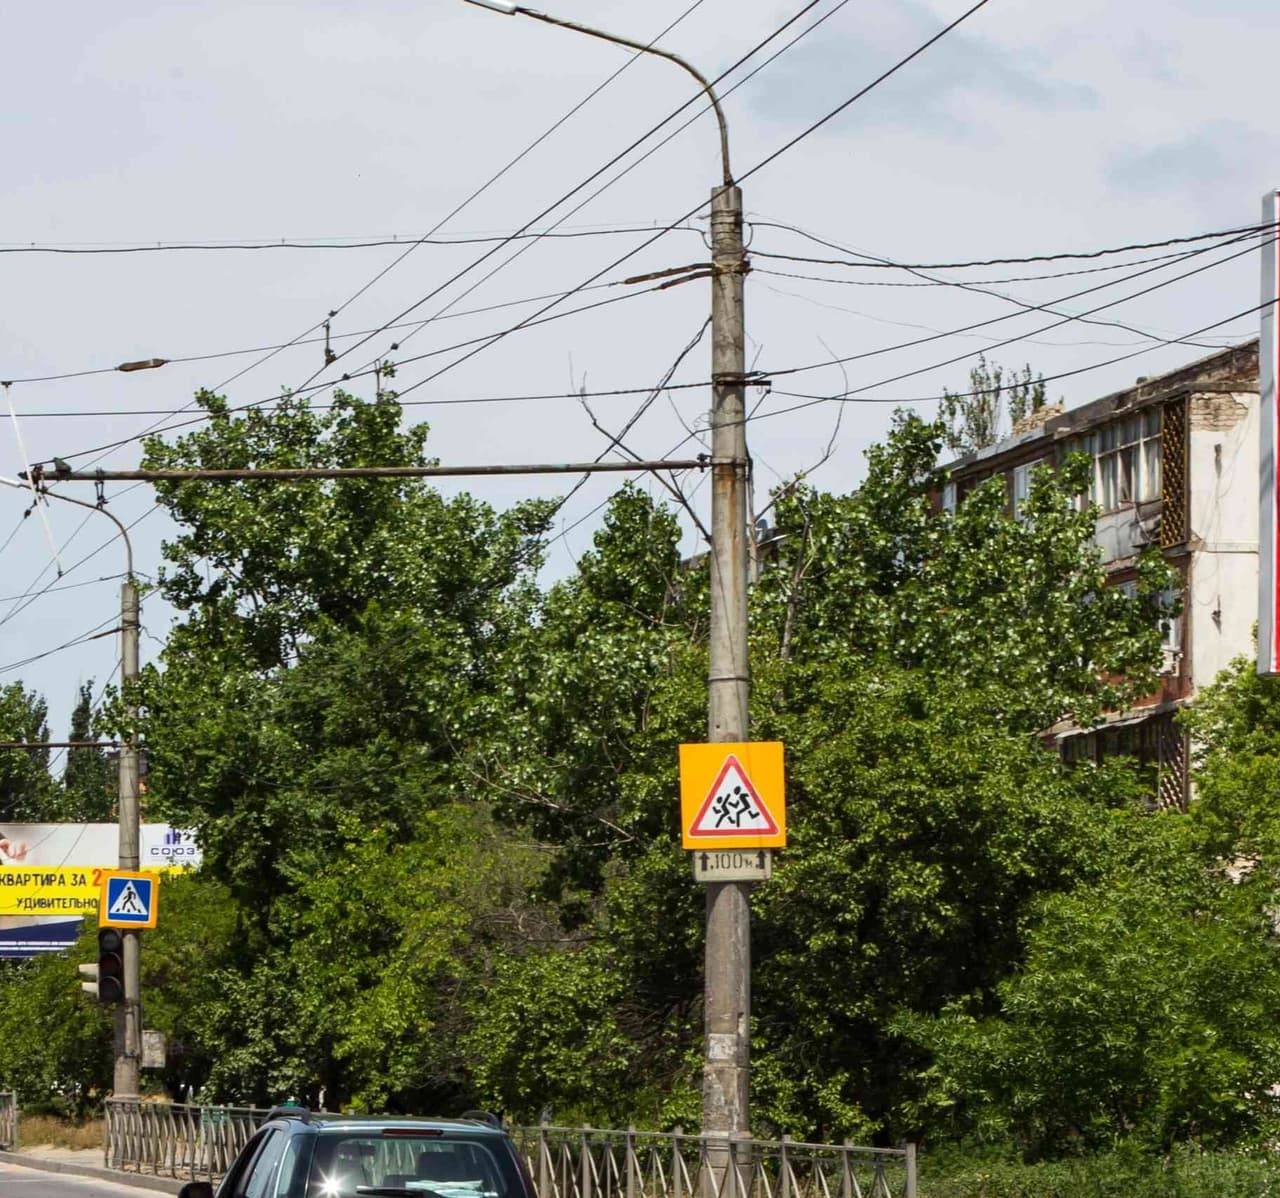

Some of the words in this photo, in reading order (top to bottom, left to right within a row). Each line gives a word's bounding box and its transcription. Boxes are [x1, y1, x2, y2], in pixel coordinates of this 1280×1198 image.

[150, 847, 195, 856] СОЮЗ
[70, 873, 87, 886] ЗА
[16, 897, 99, 910] УДИВИТЕЛЬНО
